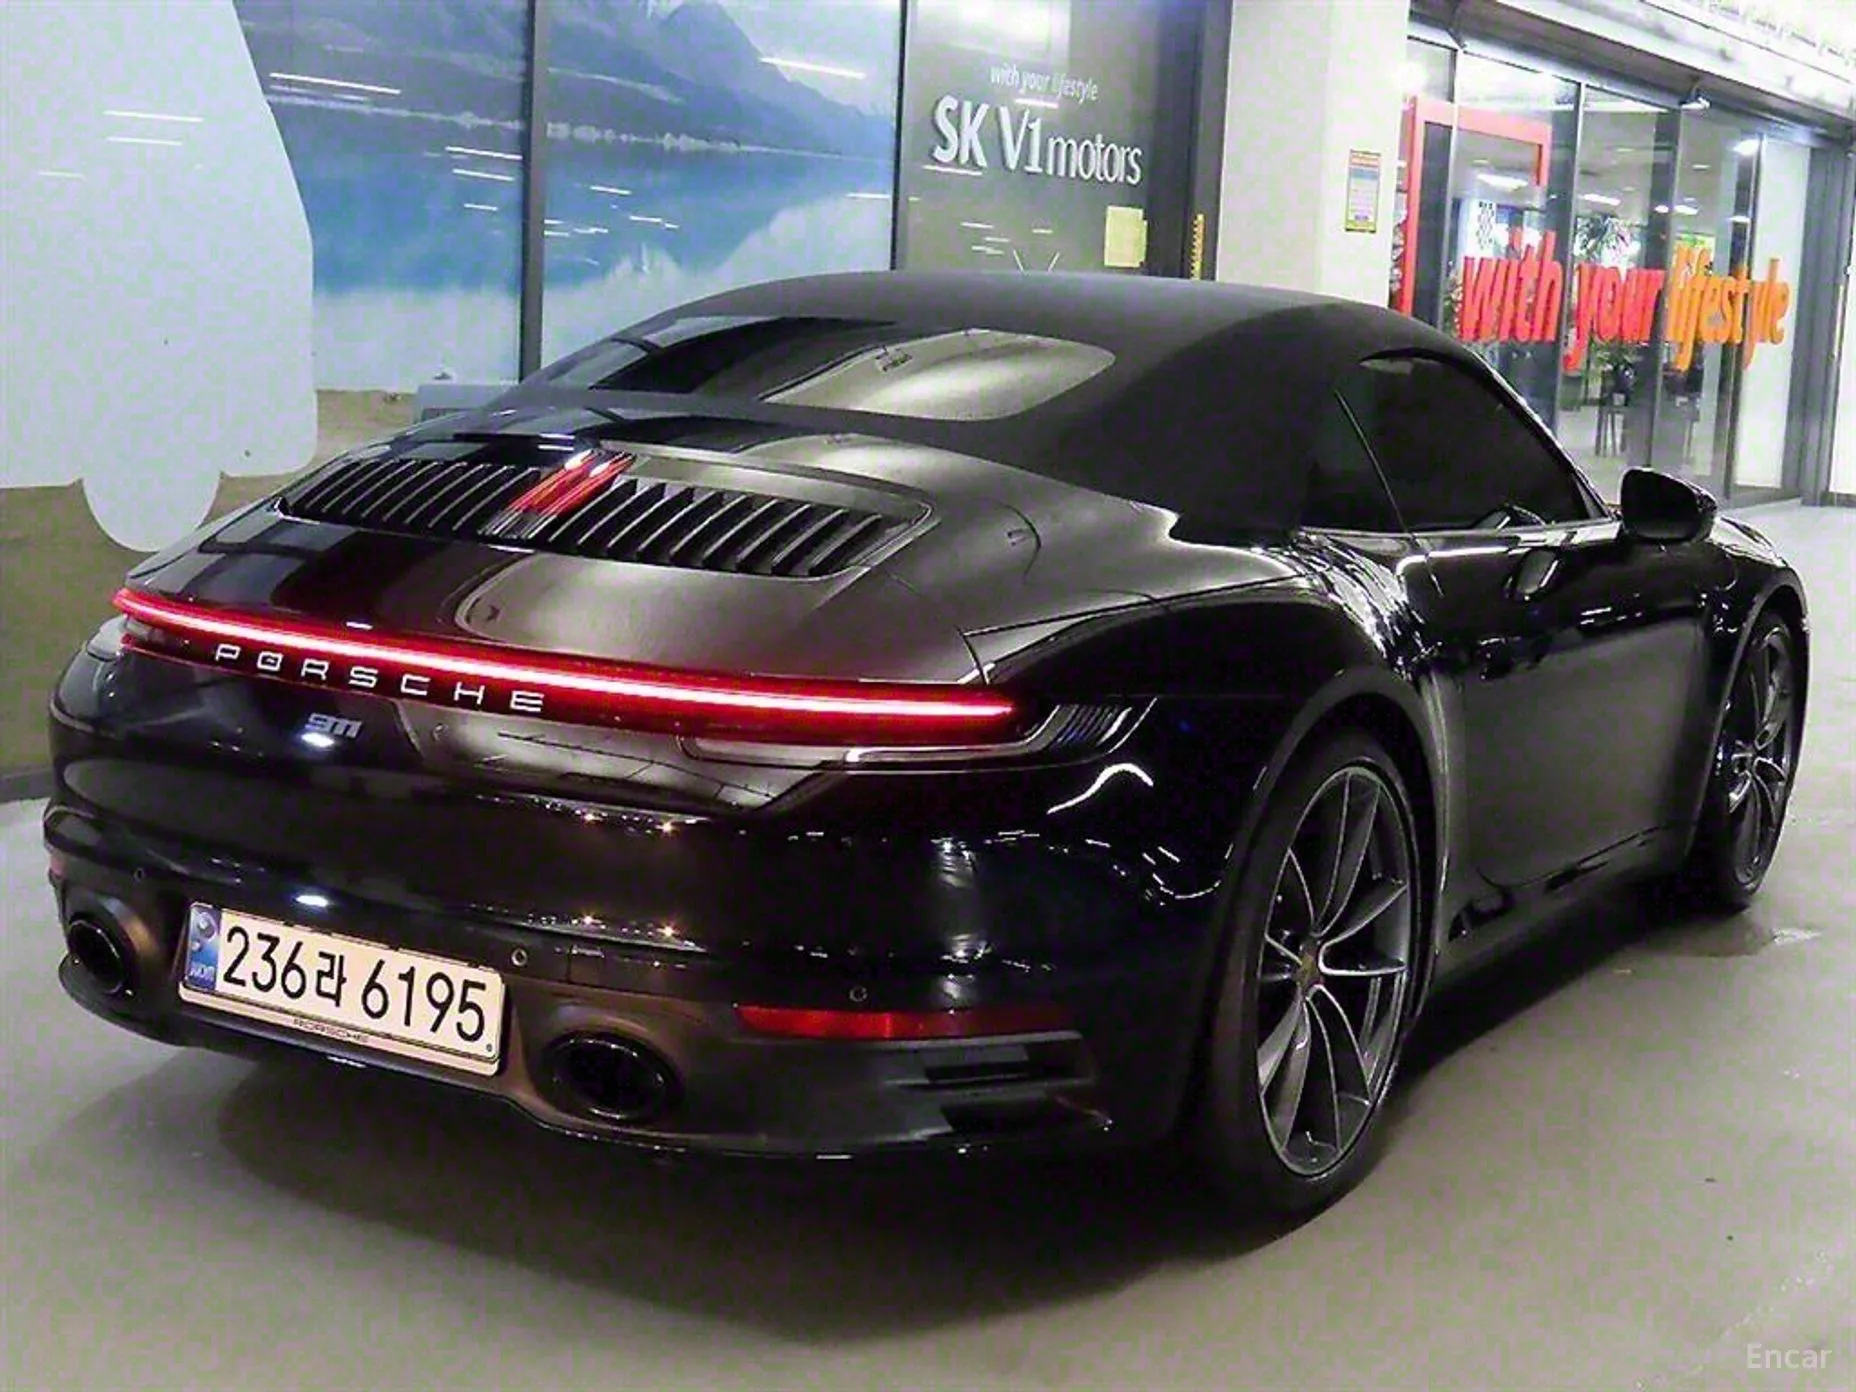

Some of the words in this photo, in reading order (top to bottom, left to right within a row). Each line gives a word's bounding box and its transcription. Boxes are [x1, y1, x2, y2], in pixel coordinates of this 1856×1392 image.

[990, 63, 1020, 87] with
[1018, 71, 1050, 96] your
[932, 95, 989, 168] SK
[999, 105, 1043, 173] V1
[1046, 133, 1143, 186] motors
[1460, 227, 1563, 343] with
[1563, 261, 1666, 374] your
[1665, 244, 1790, 373] lifestyle
[214, 643, 545, 713] PORSCHE
[305, 711, 363, 739] 911
[222, 925, 347, 1008] 236라
[361, 958, 487, 1043] 6195
